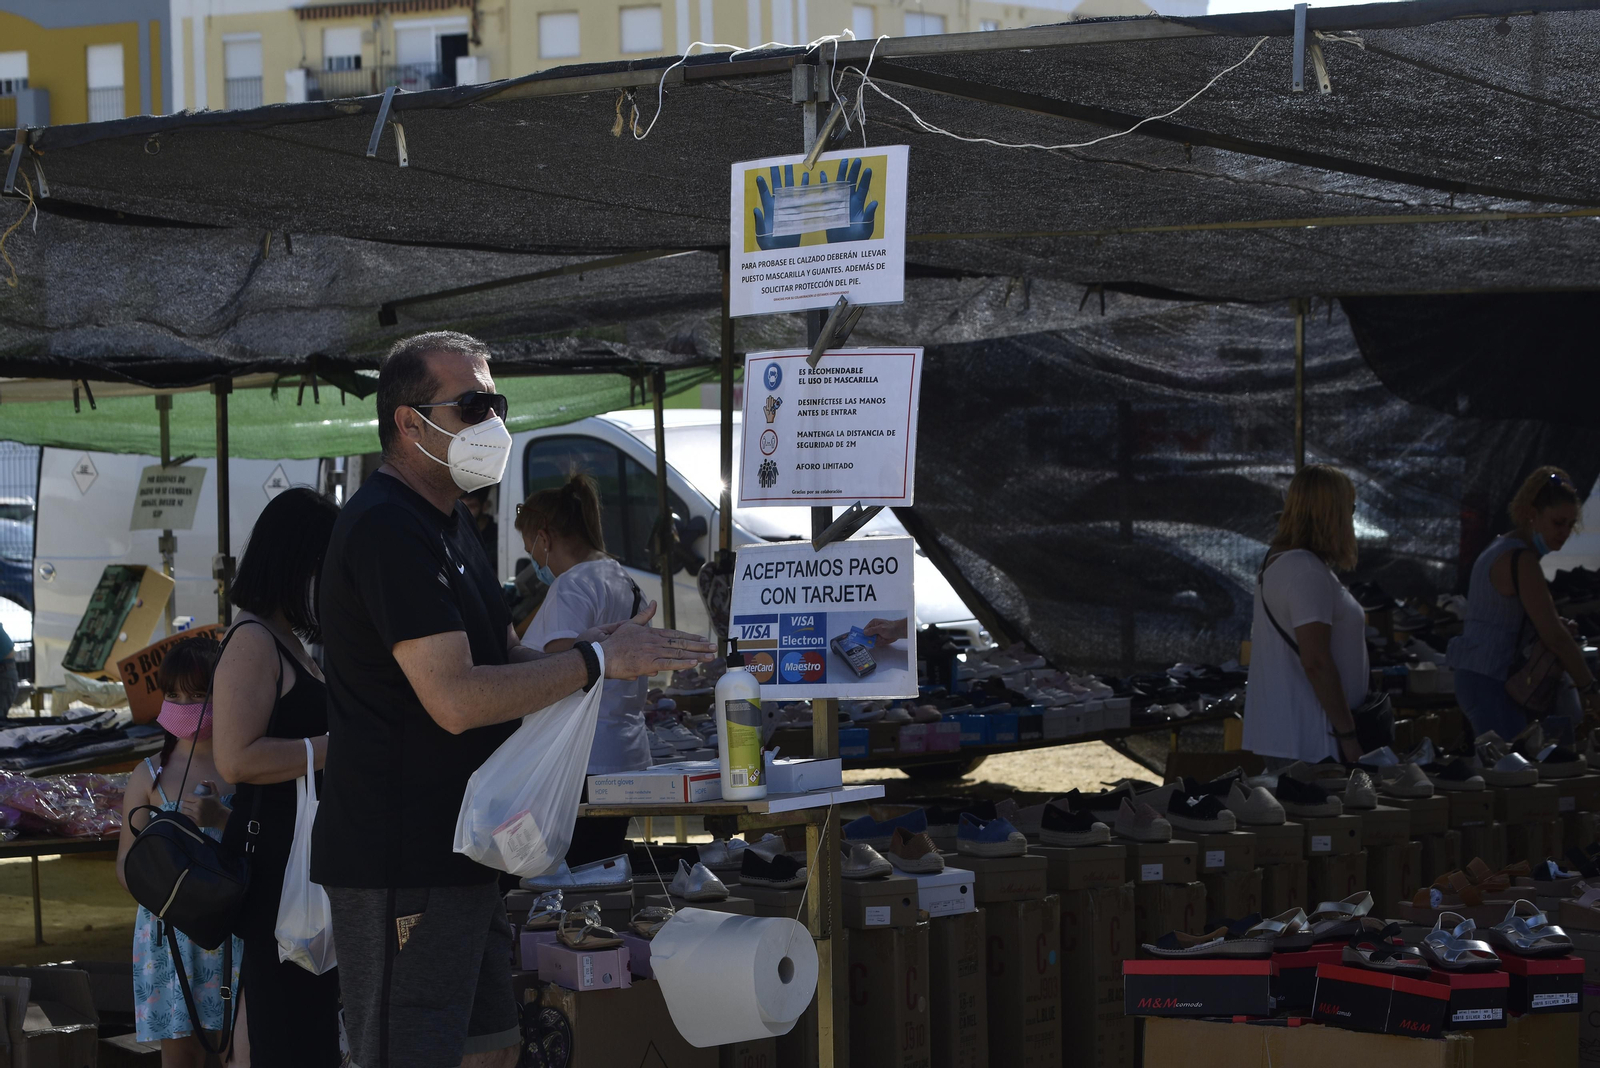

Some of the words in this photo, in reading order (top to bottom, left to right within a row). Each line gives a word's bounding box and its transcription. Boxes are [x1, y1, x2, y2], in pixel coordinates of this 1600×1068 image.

[741, 262, 757, 270] PARA
[758, 258, 787, 269] PROBASE
[797, 254, 826, 265] CALZADO
[827, 250, 858, 261] DEBERÁN
[861, 249, 887, 258] LLEVAR
[741, 273, 765, 283] PUESTO
[765, 270, 806, 281] MASCARILLA
[806, 269, 811, 277] Y
[811, 266, 844, 276] GUANTES.
[845, 262, 875, 273] ADEMÁS
[876, 262, 886, 270] DE
[761, 284, 794, 294] SOLICITAR
[794, 279, 834, 291] PROTECCIÓN
[835, 279, 847, 287] DEL
[848, 277, 861, 286] PIE.
[808, 367, 864, 376] RECOMENDABLE
[808, 377, 822, 385] USO
[834, 376, 879, 384] MASCARILLA
[797, 397, 843, 406] DESINFÉCTESE
[844, 397, 857, 405] LAS
[859, 397, 886, 405] MANOS
[797, 409, 819, 417] ANTES
[830, 408, 857, 416] ENTRAR
[797, 430, 835, 438] MANTENGA
[847, 429, 885, 437] DISTANCIA
[886, 429, 896, 437] DE
[796, 441, 834, 449] SEGURIDAD
[822, 462, 854, 470] LIMITADO
[742, 558, 843, 581] ACEPTAMOS
[849, 556, 899, 576] PAGO
[760, 586, 796, 605] CON
[801, 584, 877, 604] TARJETA
[790, 615, 815, 626] VISA
[741, 624, 771, 639] VISA
[782, 635, 824, 646] Electron
[744, 662, 774, 673] sterCard
[784, 662, 821, 672] Maestro
[124, 662, 139, 686] 3
[594, 778, 617, 786] comfort
[617, 778, 634, 787] gloves
[671, 780, 675, 789] L
[1036, 933, 1047, 975] C
[906, 965, 918, 1011] C
[1107, 987, 1123, 1002] BLAC
[1137, 997, 1178, 1009] M&M
[1318, 1002, 1339, 1016] M&M
[1399, 1019, 1431, 1033] M&M
[902, 1022, 925, 1051] J910
